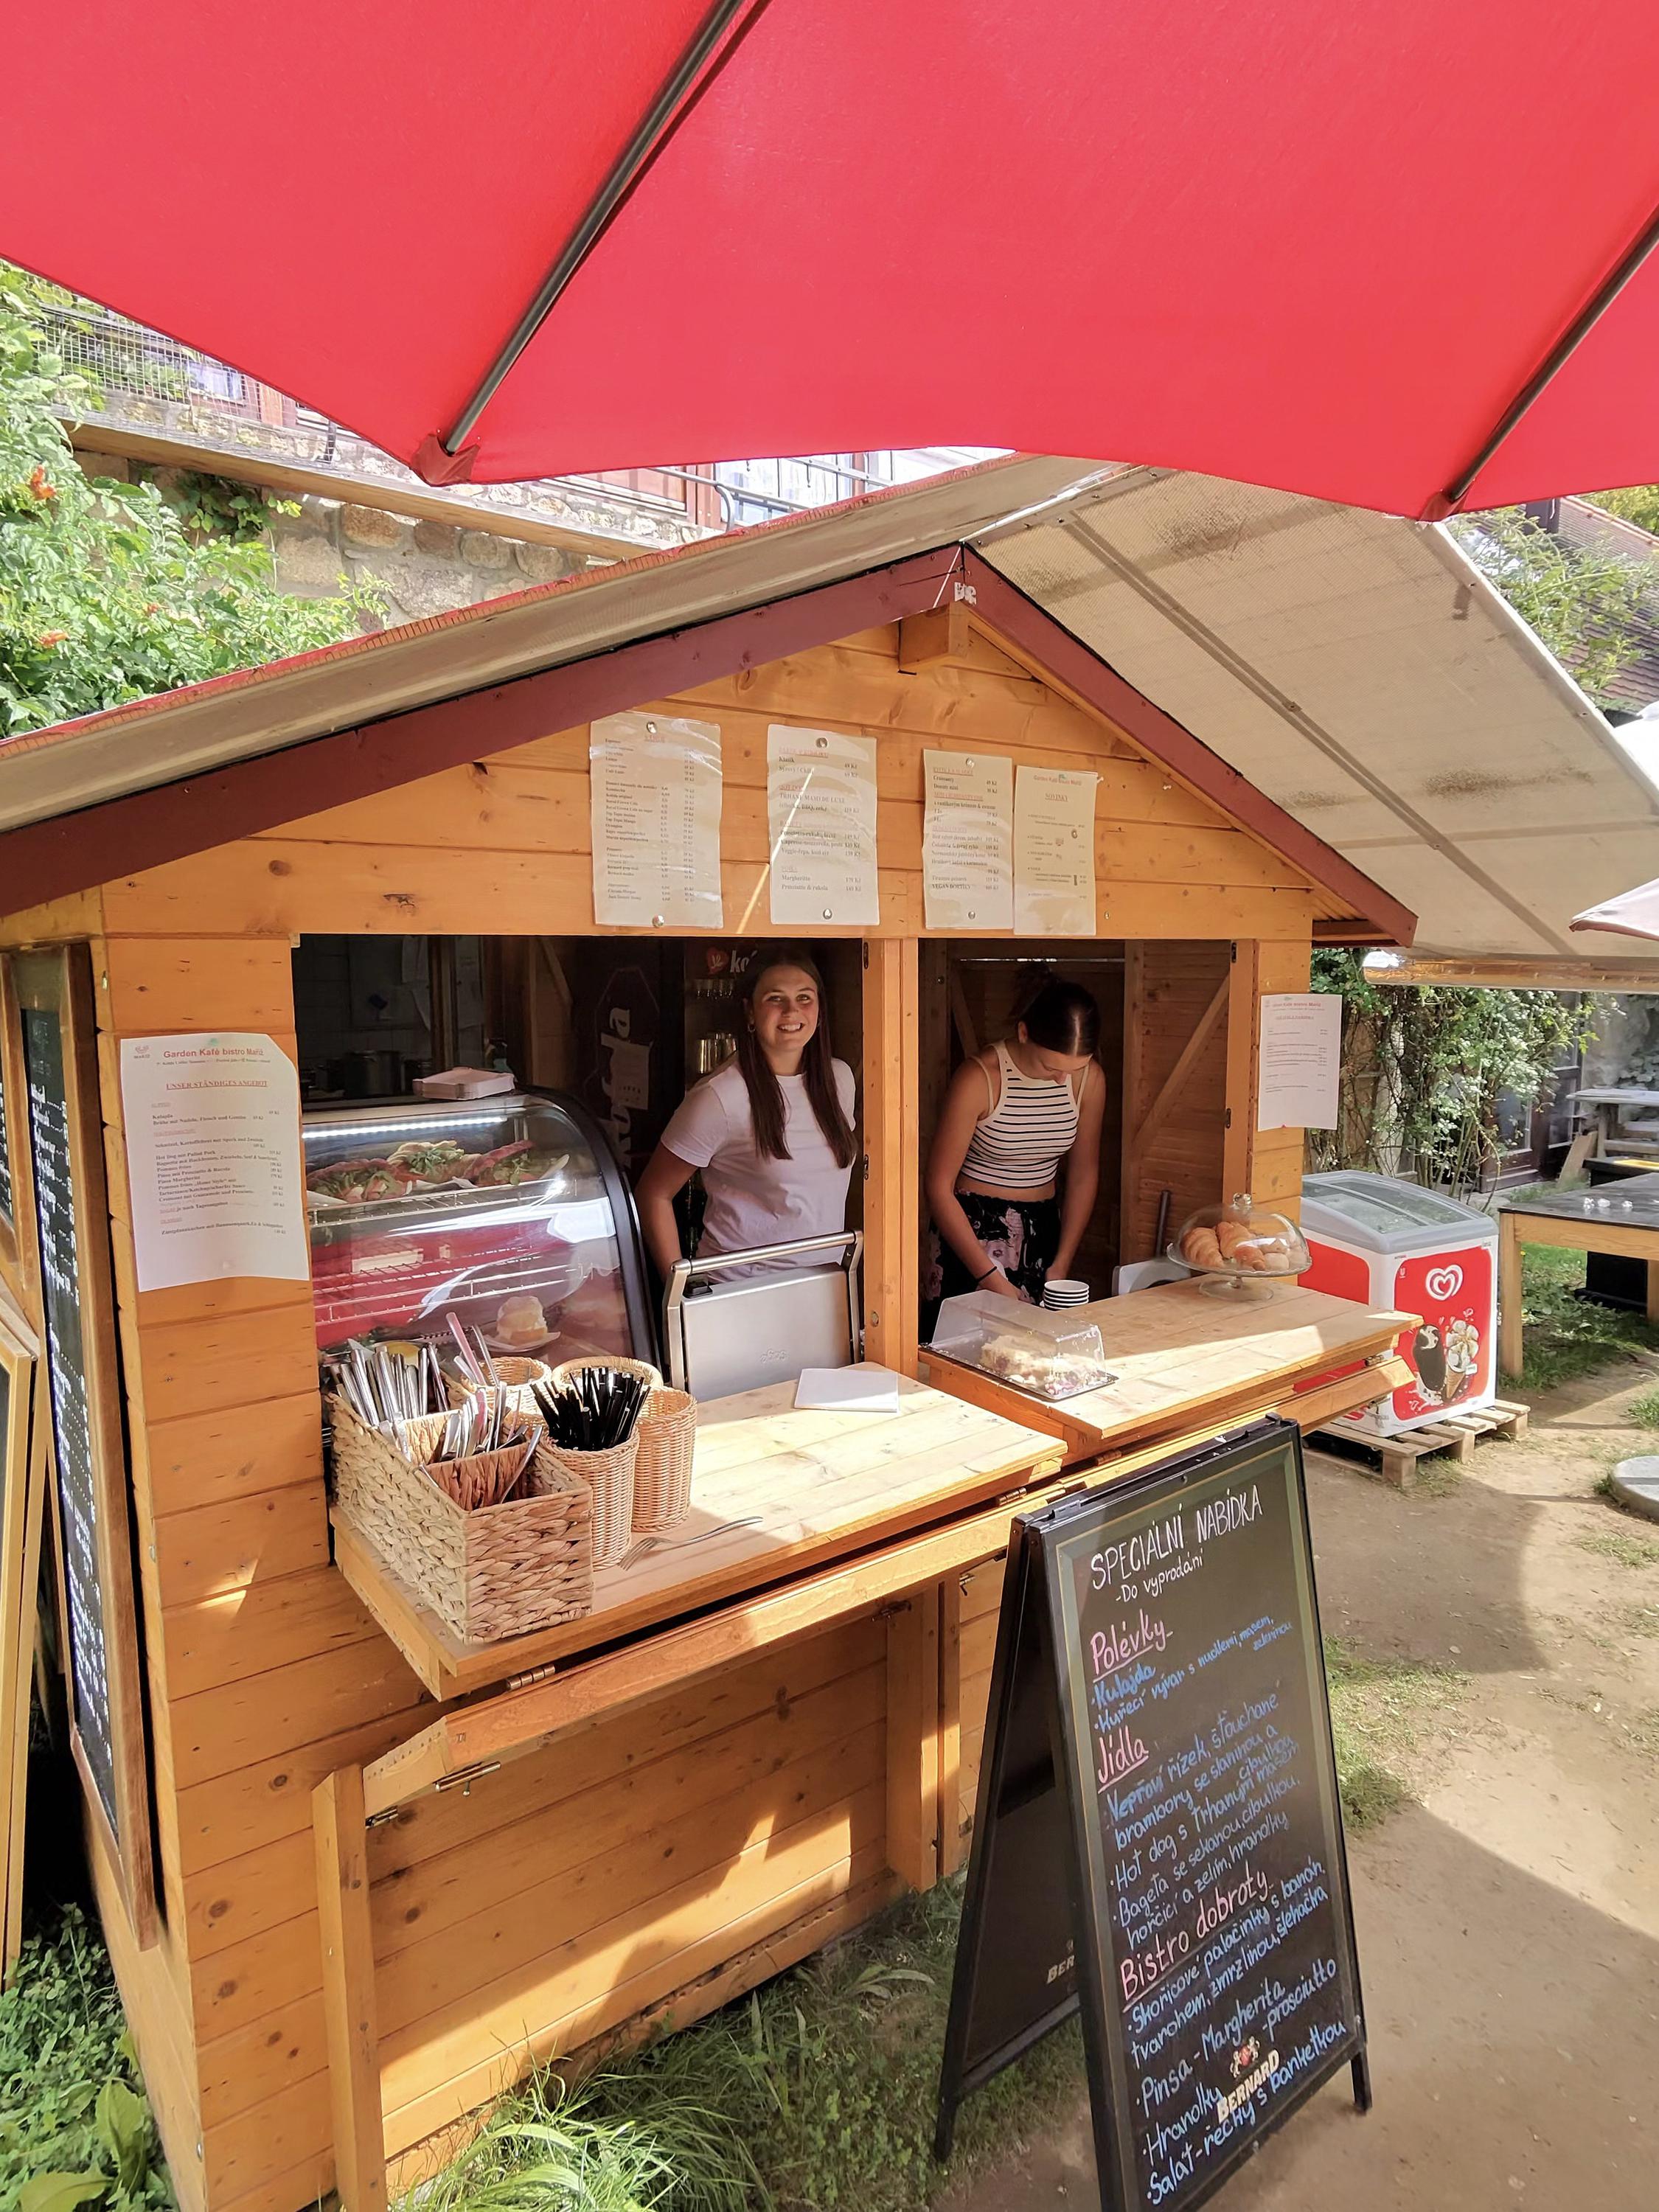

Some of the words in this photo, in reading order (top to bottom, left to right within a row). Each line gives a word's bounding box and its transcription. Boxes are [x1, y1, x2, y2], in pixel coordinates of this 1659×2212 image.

[163, 1050, 197, 1059] Garden
[222, 1048, 246, 1056] bistro
[1091, 1503, 1184, 1590] SPECIÁLNÍ
[1196, 1484, 1263, 1543] NABÍDKA
[1143, 1547, 1204, 1598] vyprodání
[1094, 1663, 1156, 1710] Kulajda
[1189, 1663, 1195, 1675] s
[1098, 1724, 1149, 1784] Jídla
[1114, 1789, 1194, 1851] brambory
[1194, 1773, 1211, 1792] se
[1211, 1733, 1264, 1780] slaninou
[1266, 1724, 1279, 1738] a
[1116, 1848, 1143, 1892] Hot
[1149, 1833, 1178, 1863] dog
[1178, 1823, 1188, 1840] s
[1182, 1888, 1194, 1905] a
[1229, 1810, 1290, 1865] hranolky
[1119, 1872, 1170, 1928] Bageta
[1173, 1863, 1189, 1882] se
[1276, 1885, 1329, 1938] šlehačka
[1120, 1931, 1189, 2001] Bistro
[1132, 1954, 1200, 2034] Skořicové
[1203, 1906, 1271, 1978] palačinky
[1271, 1893, 1280, 1910] s
[1141, 2057, 1194, 2118] Pinsa
[1201, 1976, 1287, 2062] Margherita
[1217, 2048, 1281, 2124] BERNARD
[1256, 2087, 1267, 2107] s
